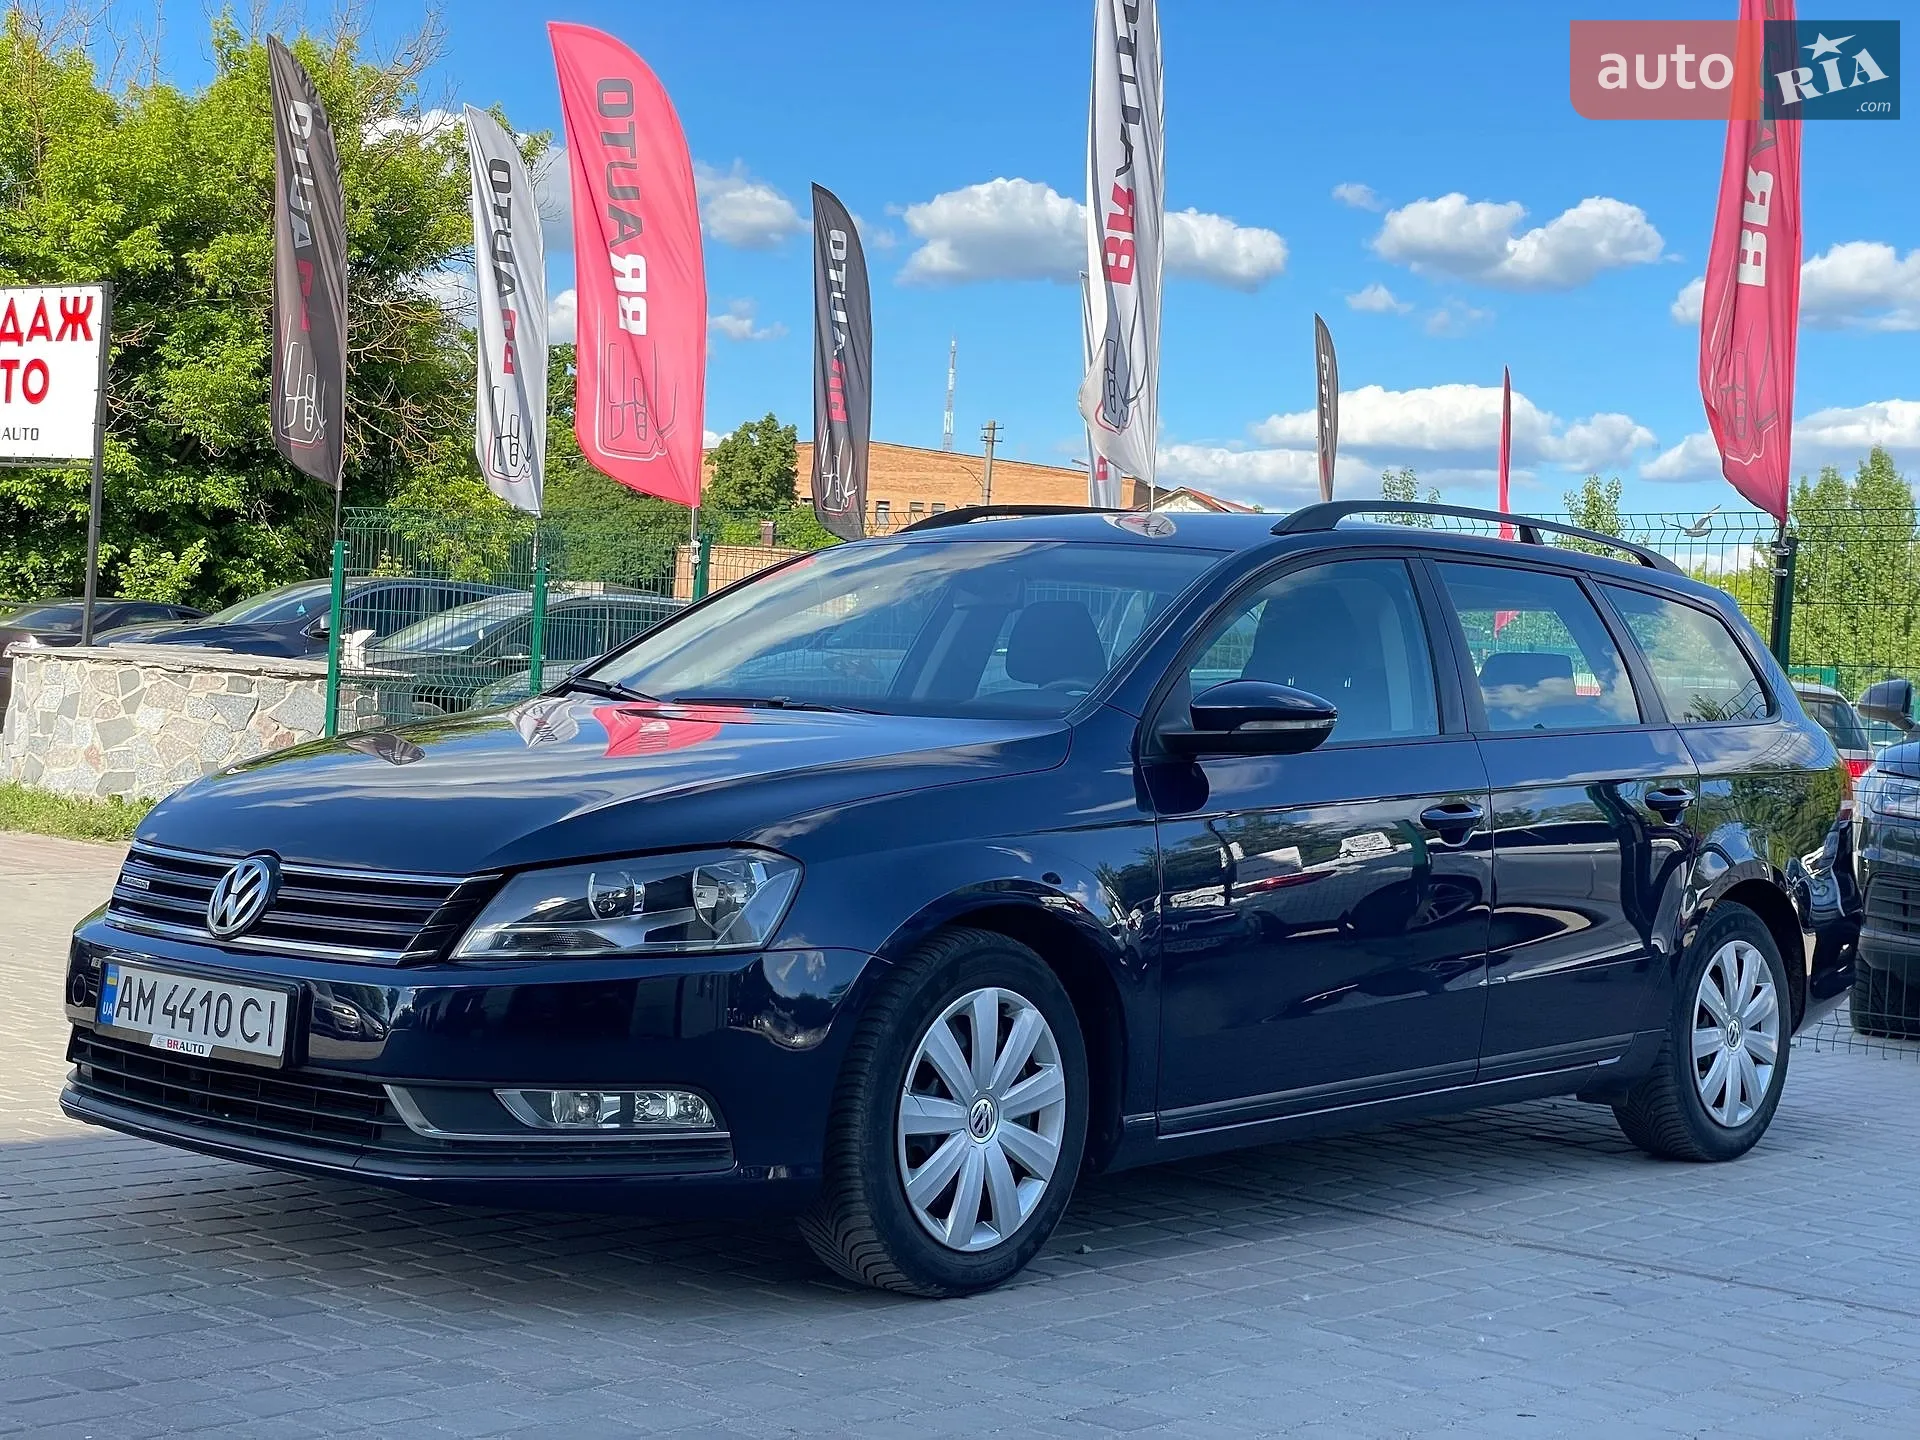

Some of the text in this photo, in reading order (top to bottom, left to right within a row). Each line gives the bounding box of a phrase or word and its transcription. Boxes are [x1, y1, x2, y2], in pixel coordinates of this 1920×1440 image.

[1, 427, 39, 441] AUTO
[102, 1002, 113, 1018] UA
[166, 1038, 205, 1056] BRAUTO
